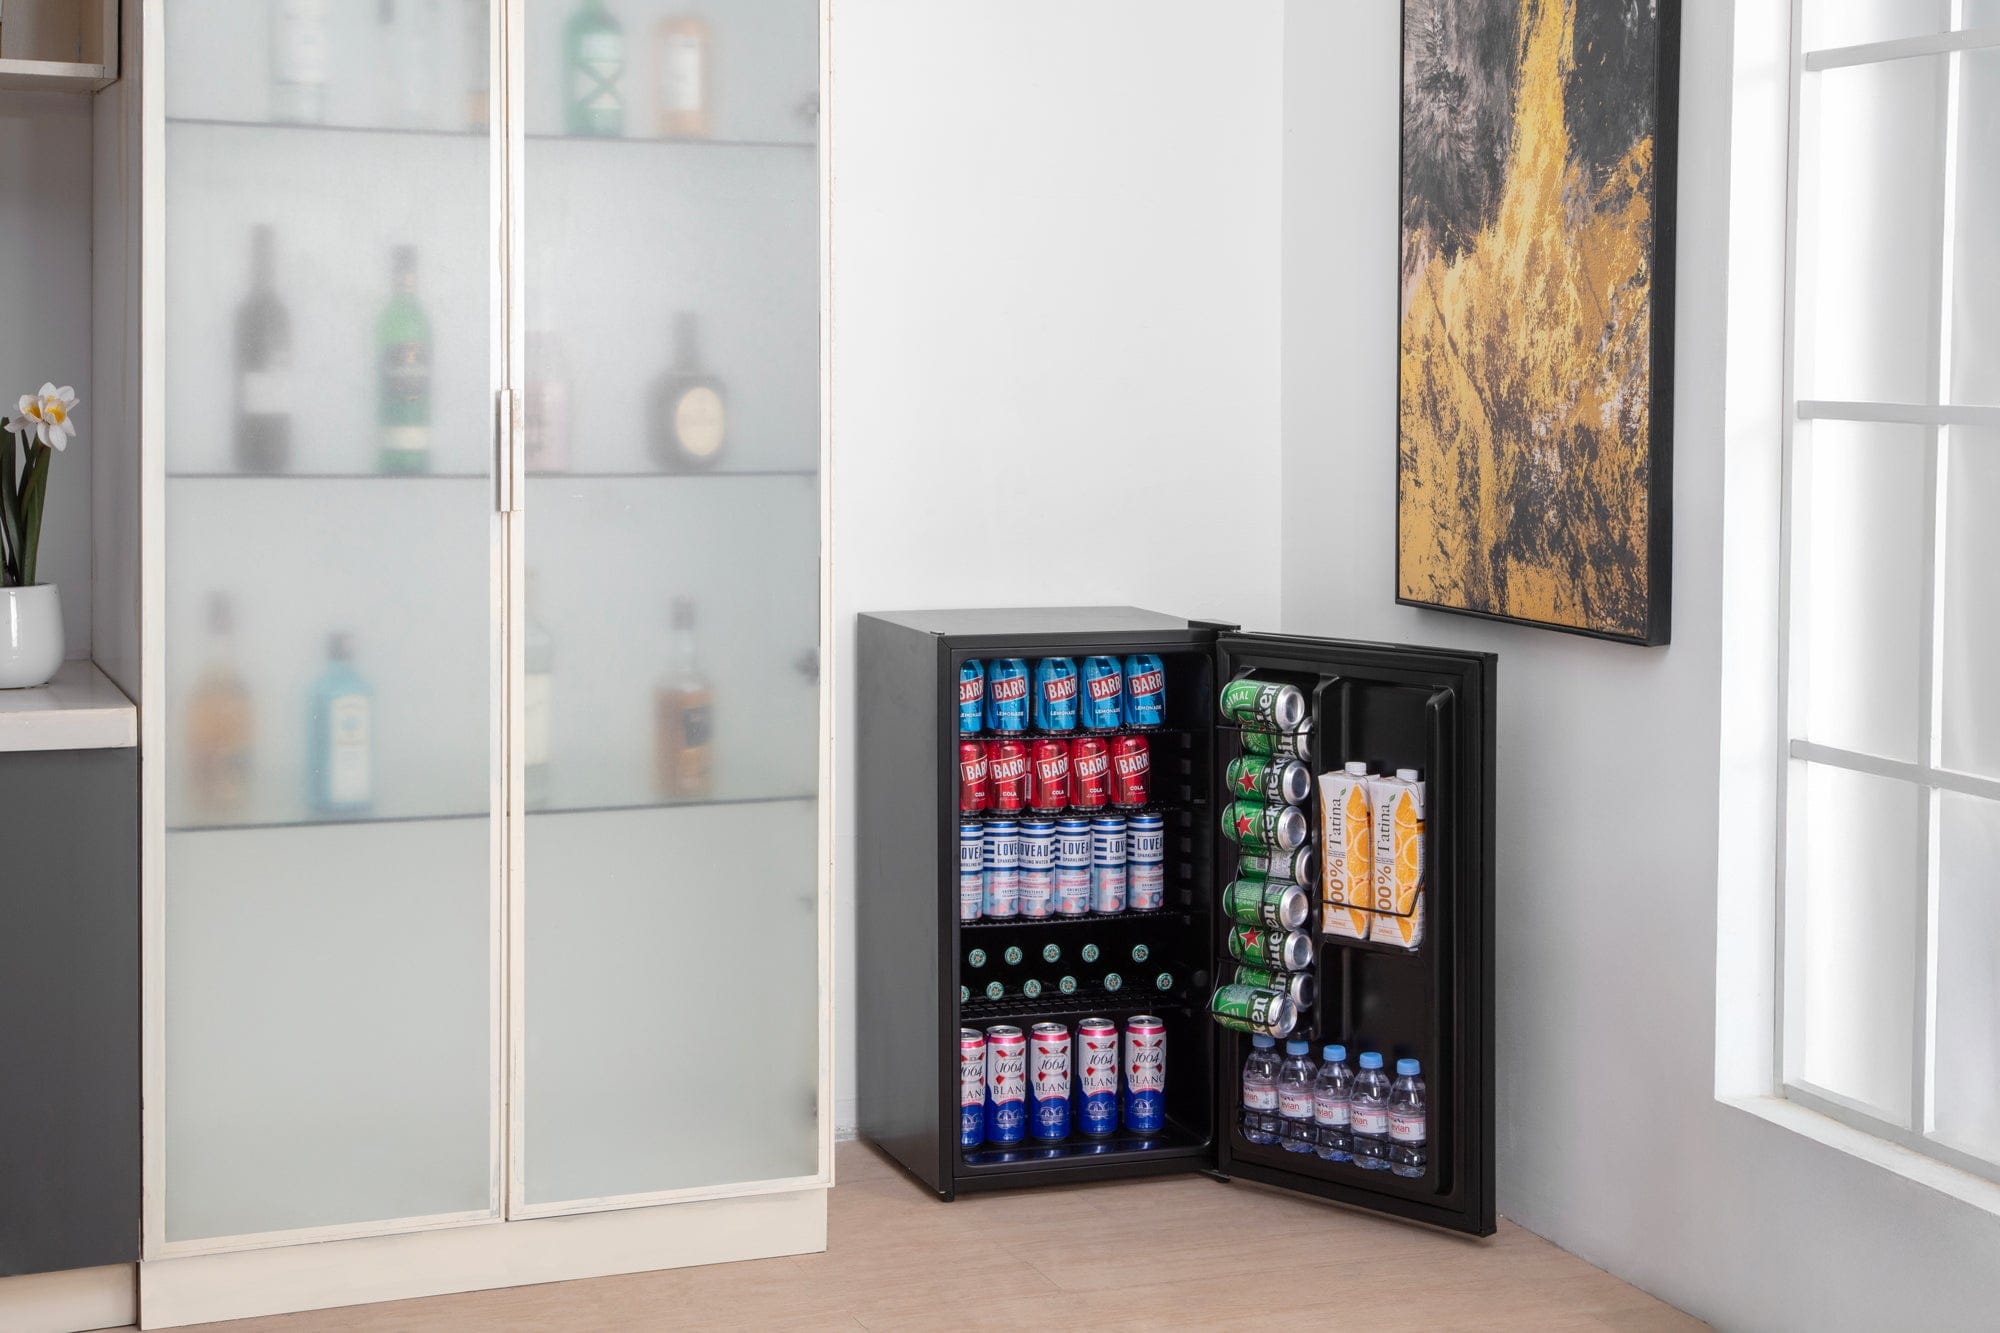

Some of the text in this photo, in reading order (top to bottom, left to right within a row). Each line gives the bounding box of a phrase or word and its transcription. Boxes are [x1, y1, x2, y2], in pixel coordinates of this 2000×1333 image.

[995, 679, 1026, 700] BARR
[1047, 678, 1076, 700] BARR
[1092, 676, 1121, 698] BARR
[1132, 673, 1163, 695] BARR
[993, 759, 1024, 779] BARR
[1080, 755, 1108, 777] BARR
[1120, 753, 1149, 774] BARR
[1327, 798, 1342, 850] Tatina
[1376, 803, 1391, 857] Tatina
[1329, 858, 1345, 913] 100%
[1377, 865, 1393, 921] 100%
[999, 1061, 1023, 1074] 1664
[1041, 1057, 1066, 1071] 1664
[1089, 1053, 1114, 1066] 1664
[1132, 1051, 1159, 1064] 1664
